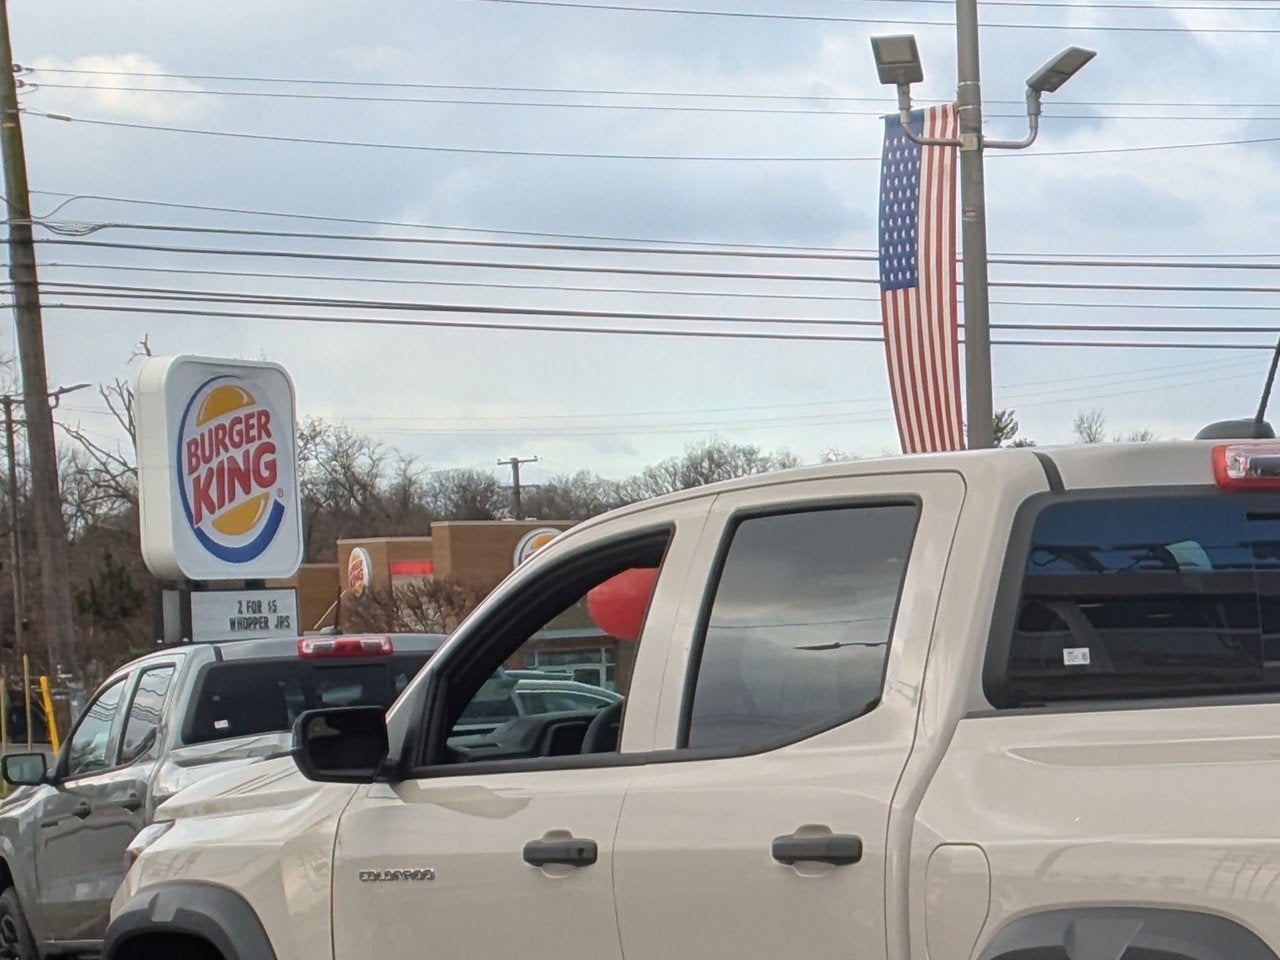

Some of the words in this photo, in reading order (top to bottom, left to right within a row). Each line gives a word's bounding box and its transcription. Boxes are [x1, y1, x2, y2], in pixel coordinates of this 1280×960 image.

[187, 409, 272, 476] BURGER
[193, 441, 277, 525] KING
[237, 600, 244, 615] 2
[246, 600, 262, 615] FOR
[267, 599, 278, 614] $5
[229, 616, 270, 632] WHOPPER
[358, 868, 436, 882] COLORADO
